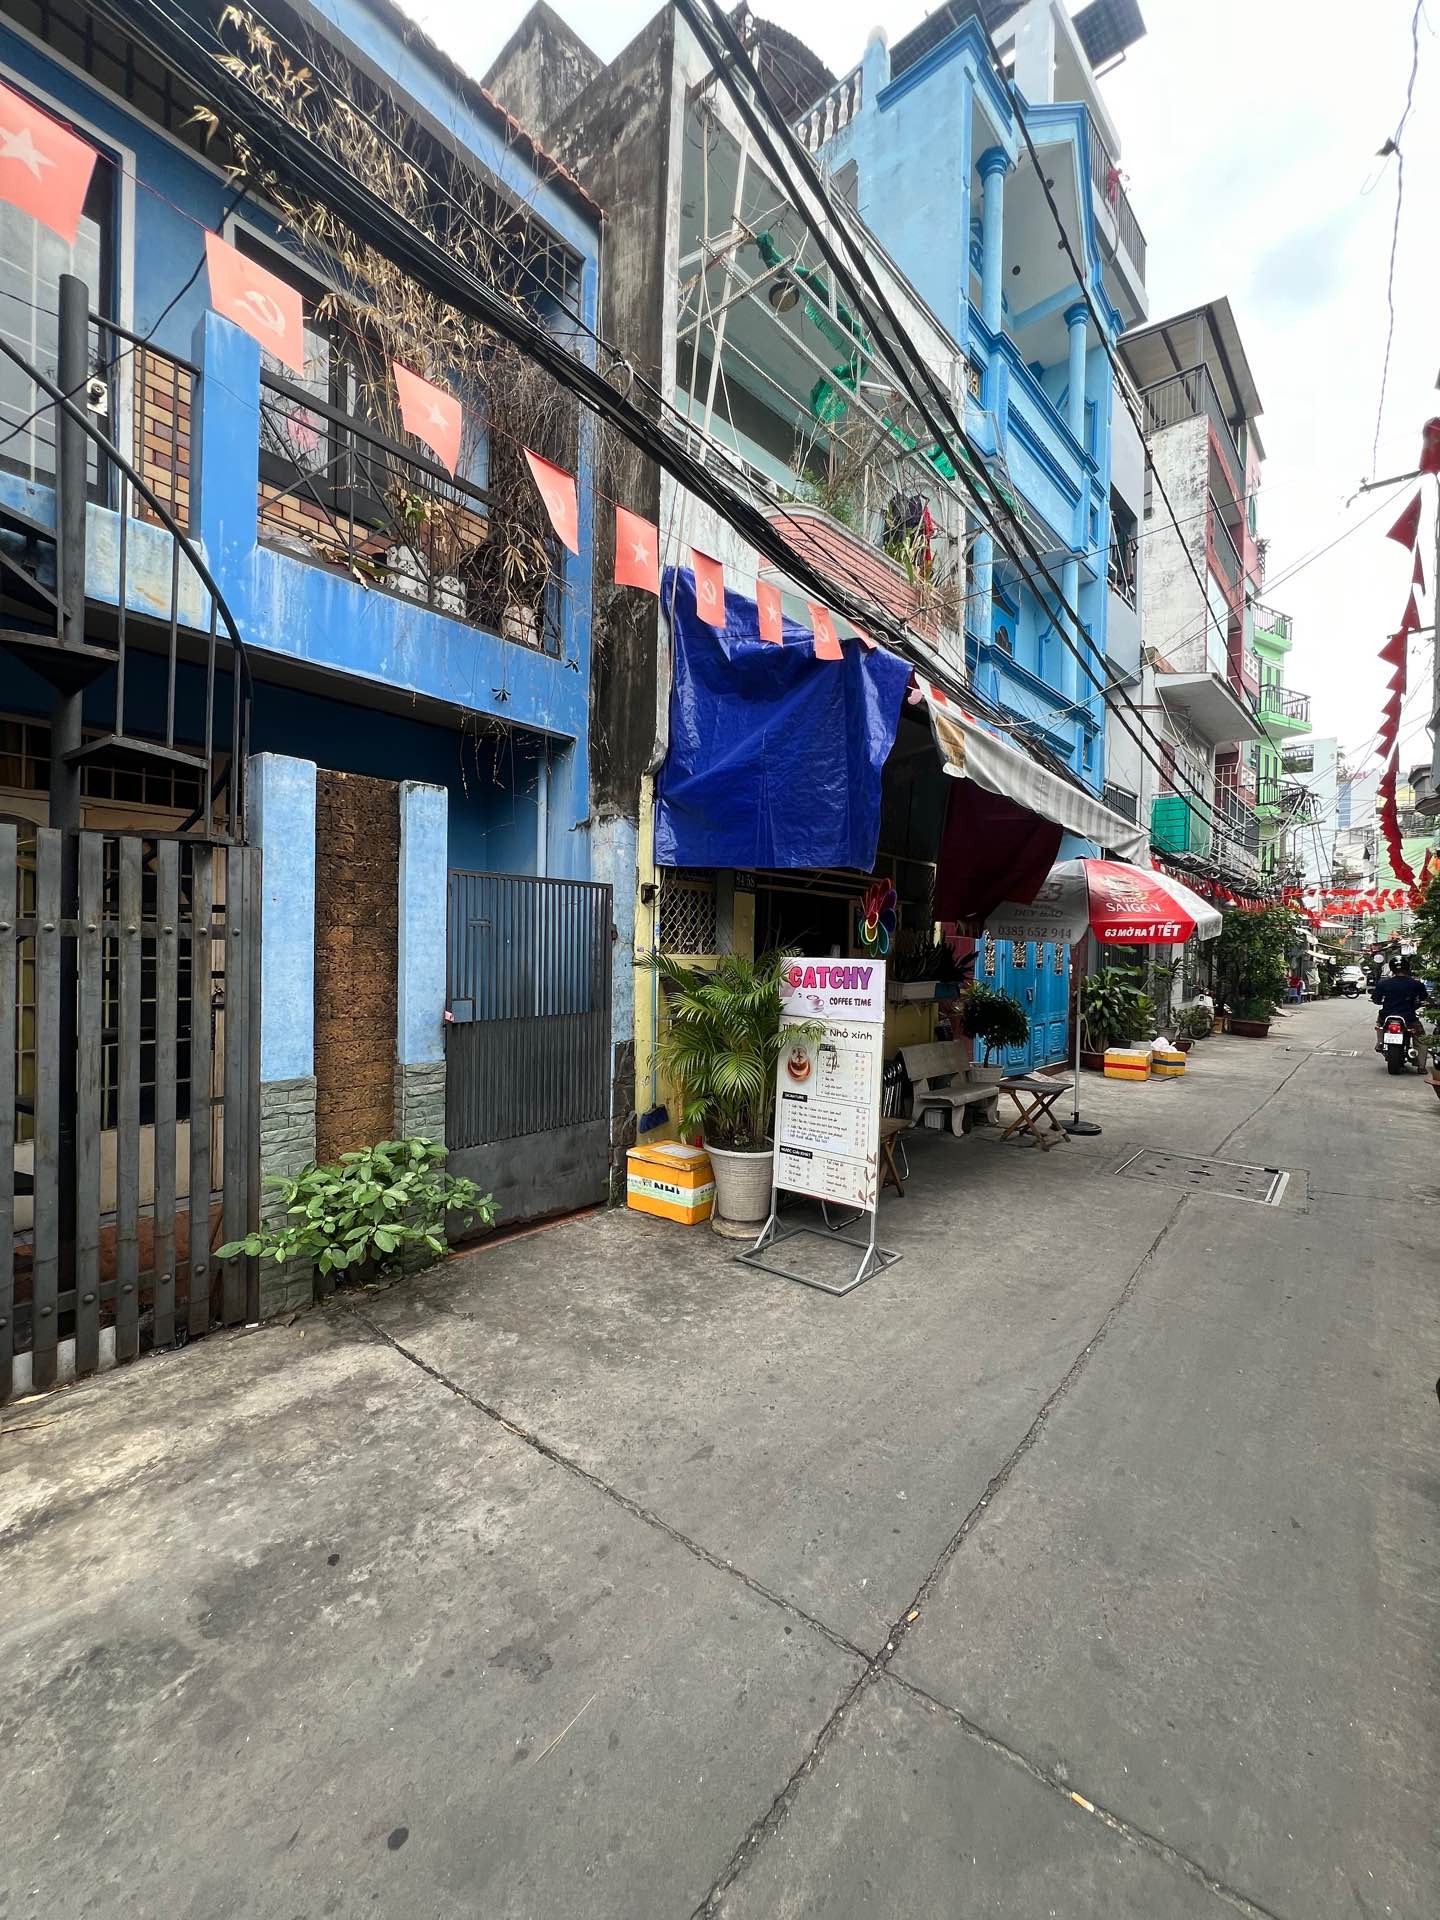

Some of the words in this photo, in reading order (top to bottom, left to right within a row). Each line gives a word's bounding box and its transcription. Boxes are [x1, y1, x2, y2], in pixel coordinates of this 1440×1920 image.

[998, 926, 1024, 936] 0385
[1027, 927, 1048, 938] 652
[1051, 928, 1072, 939] 944
[1104, 928, 1117, 937] 63
[1134, 928, 1147, 937] RA
[1148, 924, 1156, 937] 1
[1157, 920, 1181, 937] TẾT
[789, 965, 874, 990] CATCHY
[829, 996, 853, 1006] COFFEE
[854, 998, 872, 1007] TIME
[829, 1027, 849, 1038] Nhỏ
